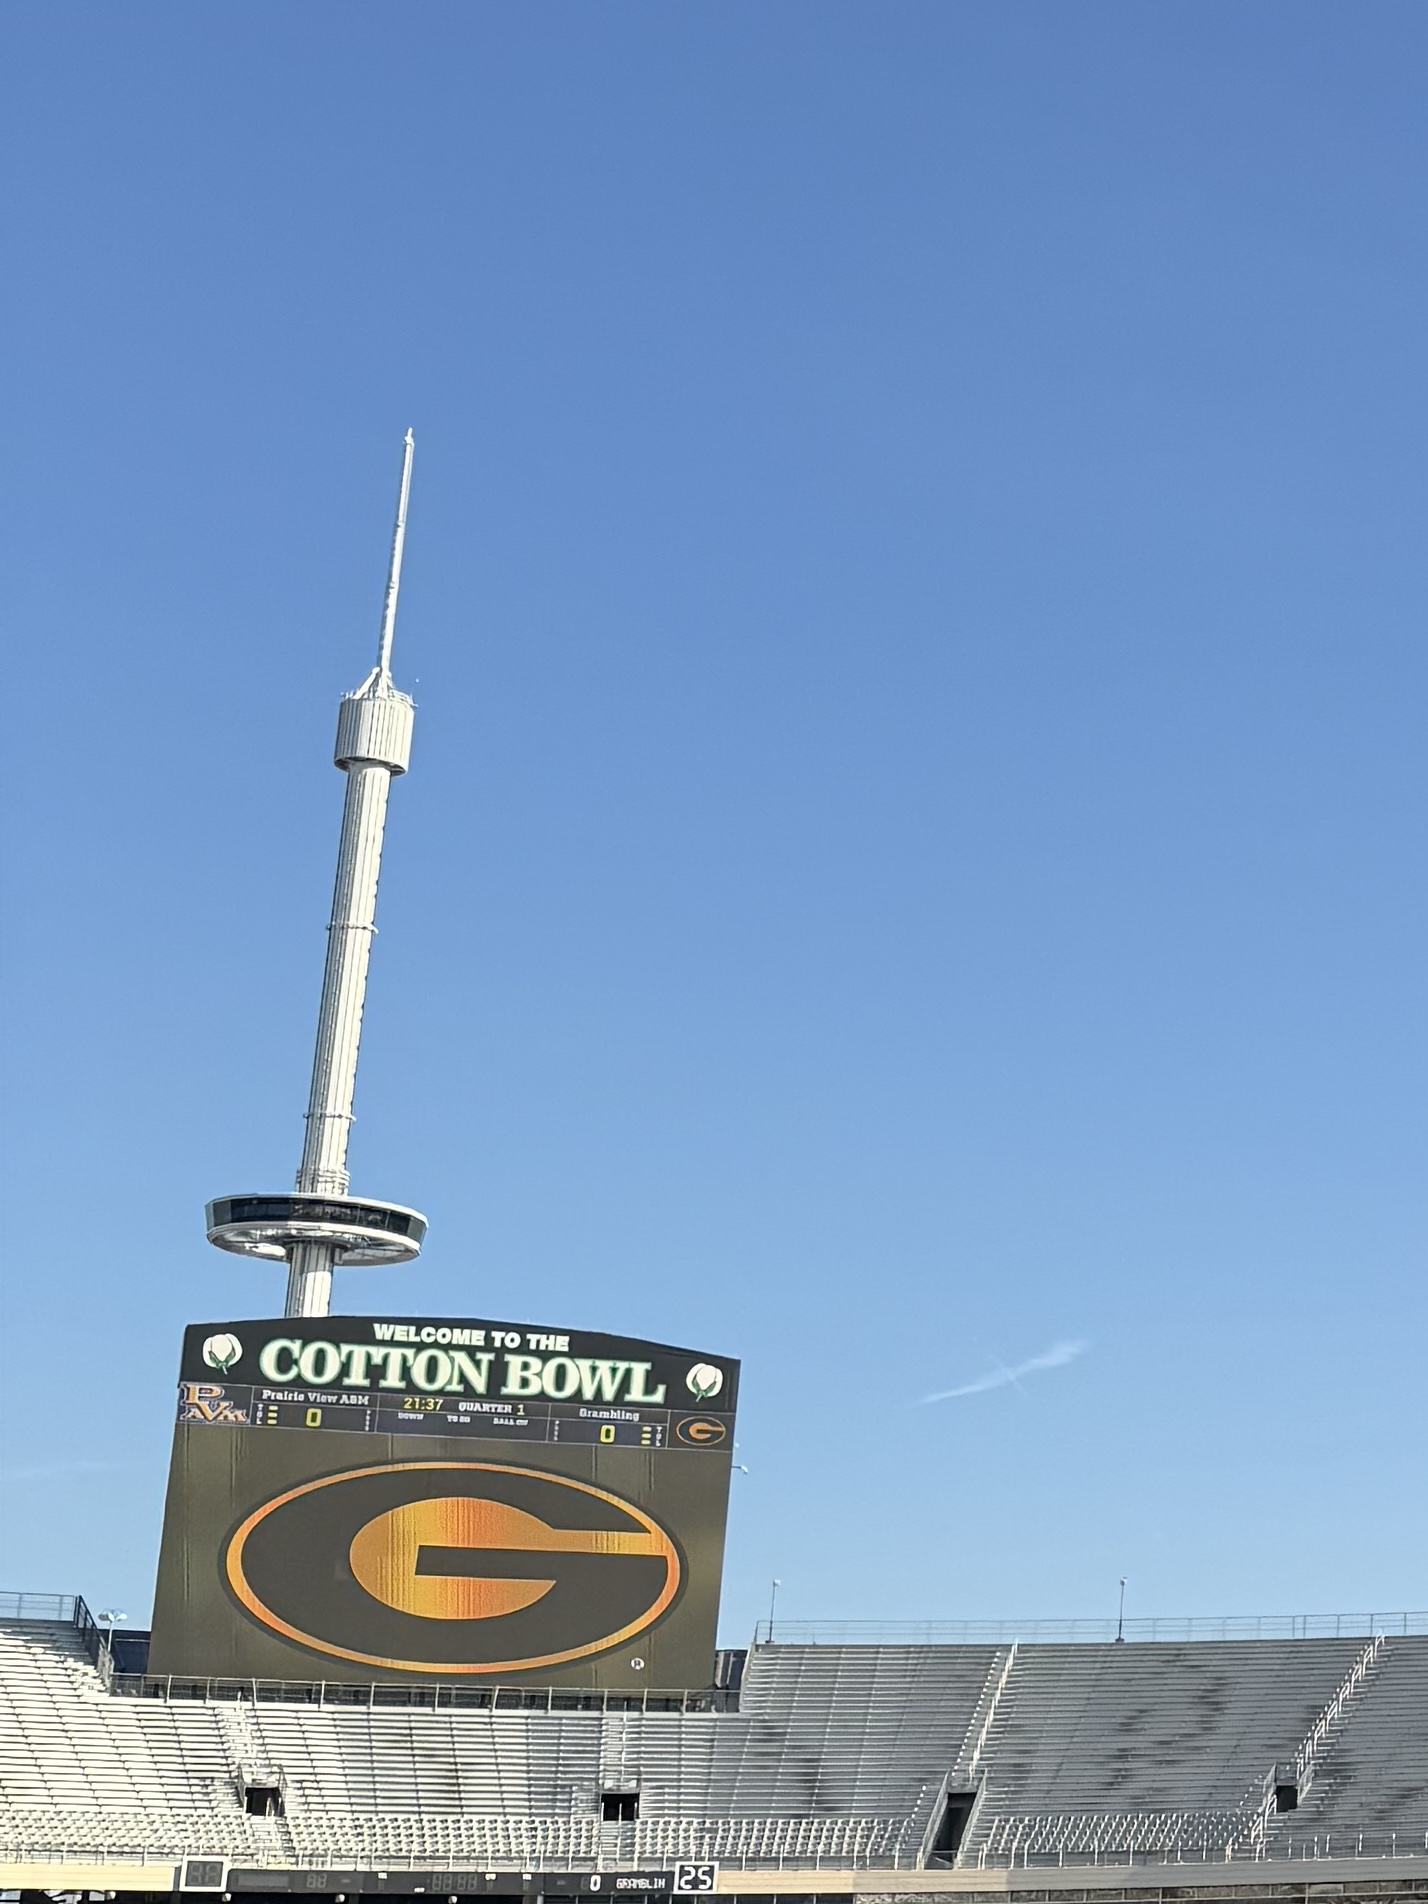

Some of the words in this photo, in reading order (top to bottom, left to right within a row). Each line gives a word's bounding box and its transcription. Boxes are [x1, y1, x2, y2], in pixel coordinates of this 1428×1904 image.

[373, 1323, 486, 1346] WELCOME
[491, 1331, 522, 1348] TO
[526, 1334, 570, 1352] THE
[259, 1338, 495, 1395] COTTON
[500, 1354, 667, 1405] BOWL
[261, 1389, 304, 1402] Prairie
[307, 1391, 338, 1404] View
[403, 1397, 443, 1411] 21:37
[305, 1407, 322, 1427] 0
[458, 1402, 513, 1413] QUARTER
[516, 1404, 525, 1416] 1
[600, 1424, 616, 1443] 0
[679, 1865, 712, 1891] 25
